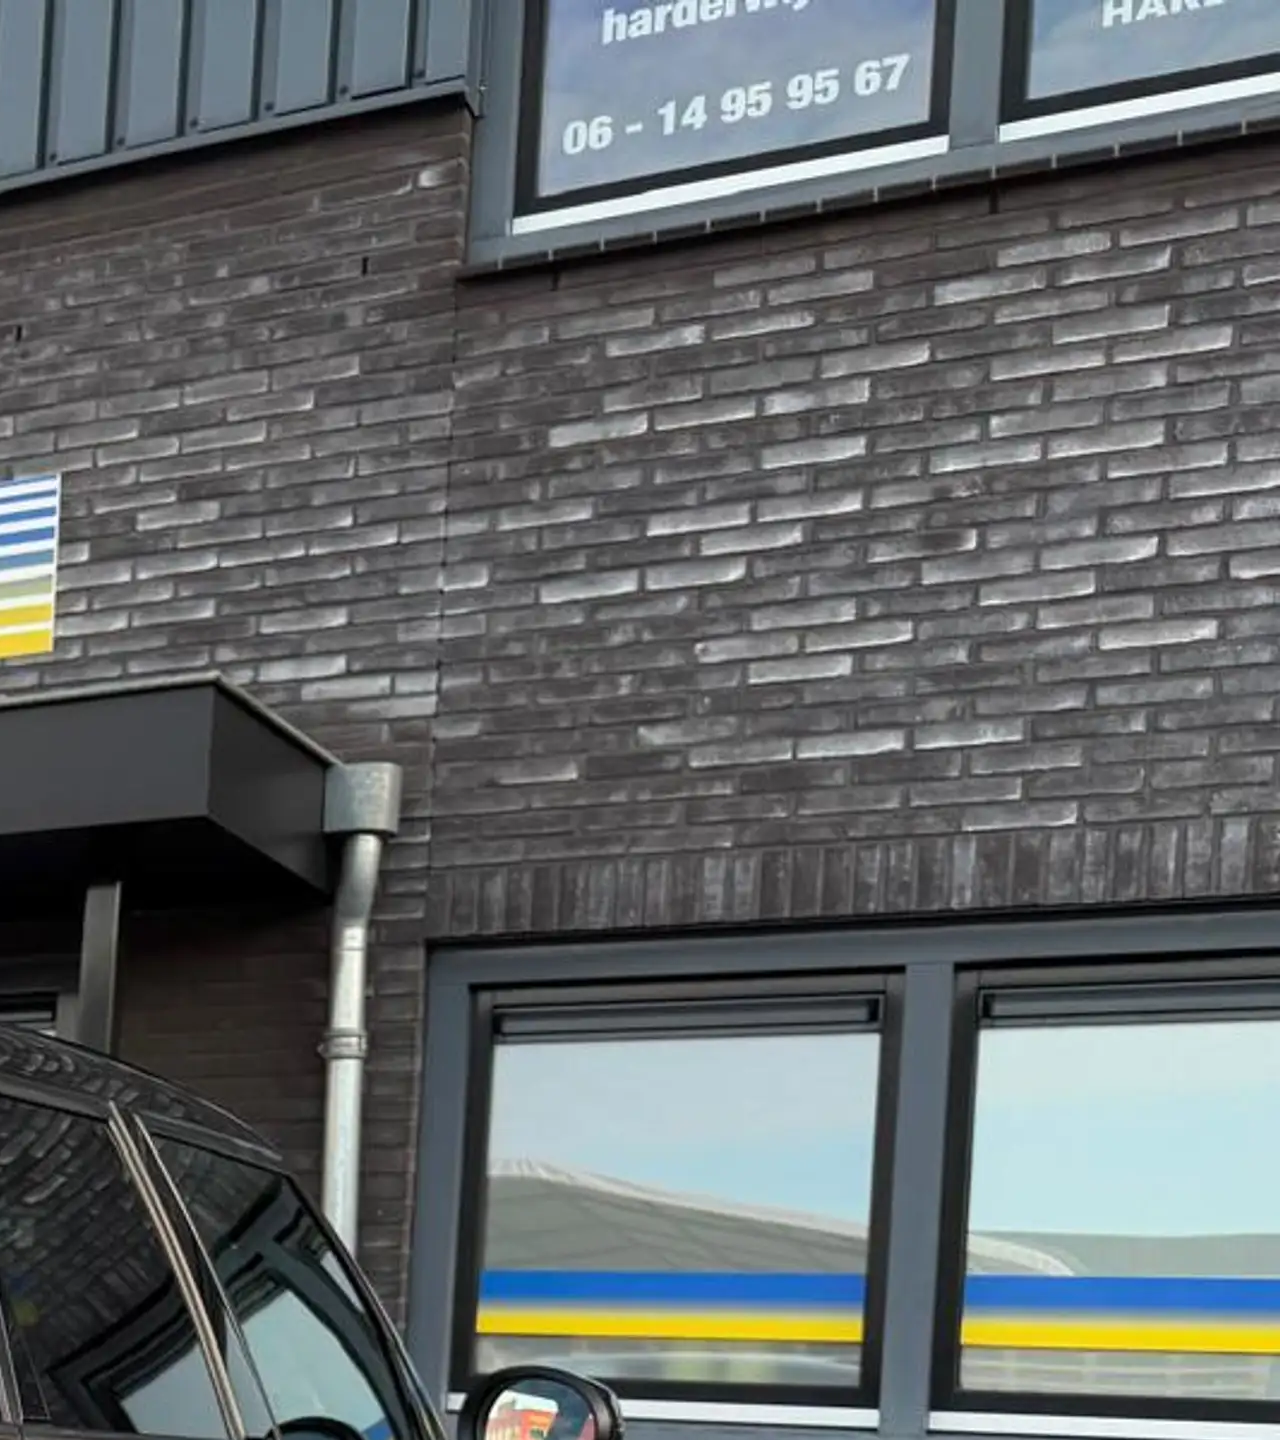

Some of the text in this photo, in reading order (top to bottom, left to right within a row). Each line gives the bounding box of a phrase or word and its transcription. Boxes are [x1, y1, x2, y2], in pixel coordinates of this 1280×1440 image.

[562, 115, 613, 154] 06
[657, 95, 708, 135] 14
[720, 82, 772, 123] 95
[786, 69, 840, 109] 95
[854, 53, 910, 97] 67
